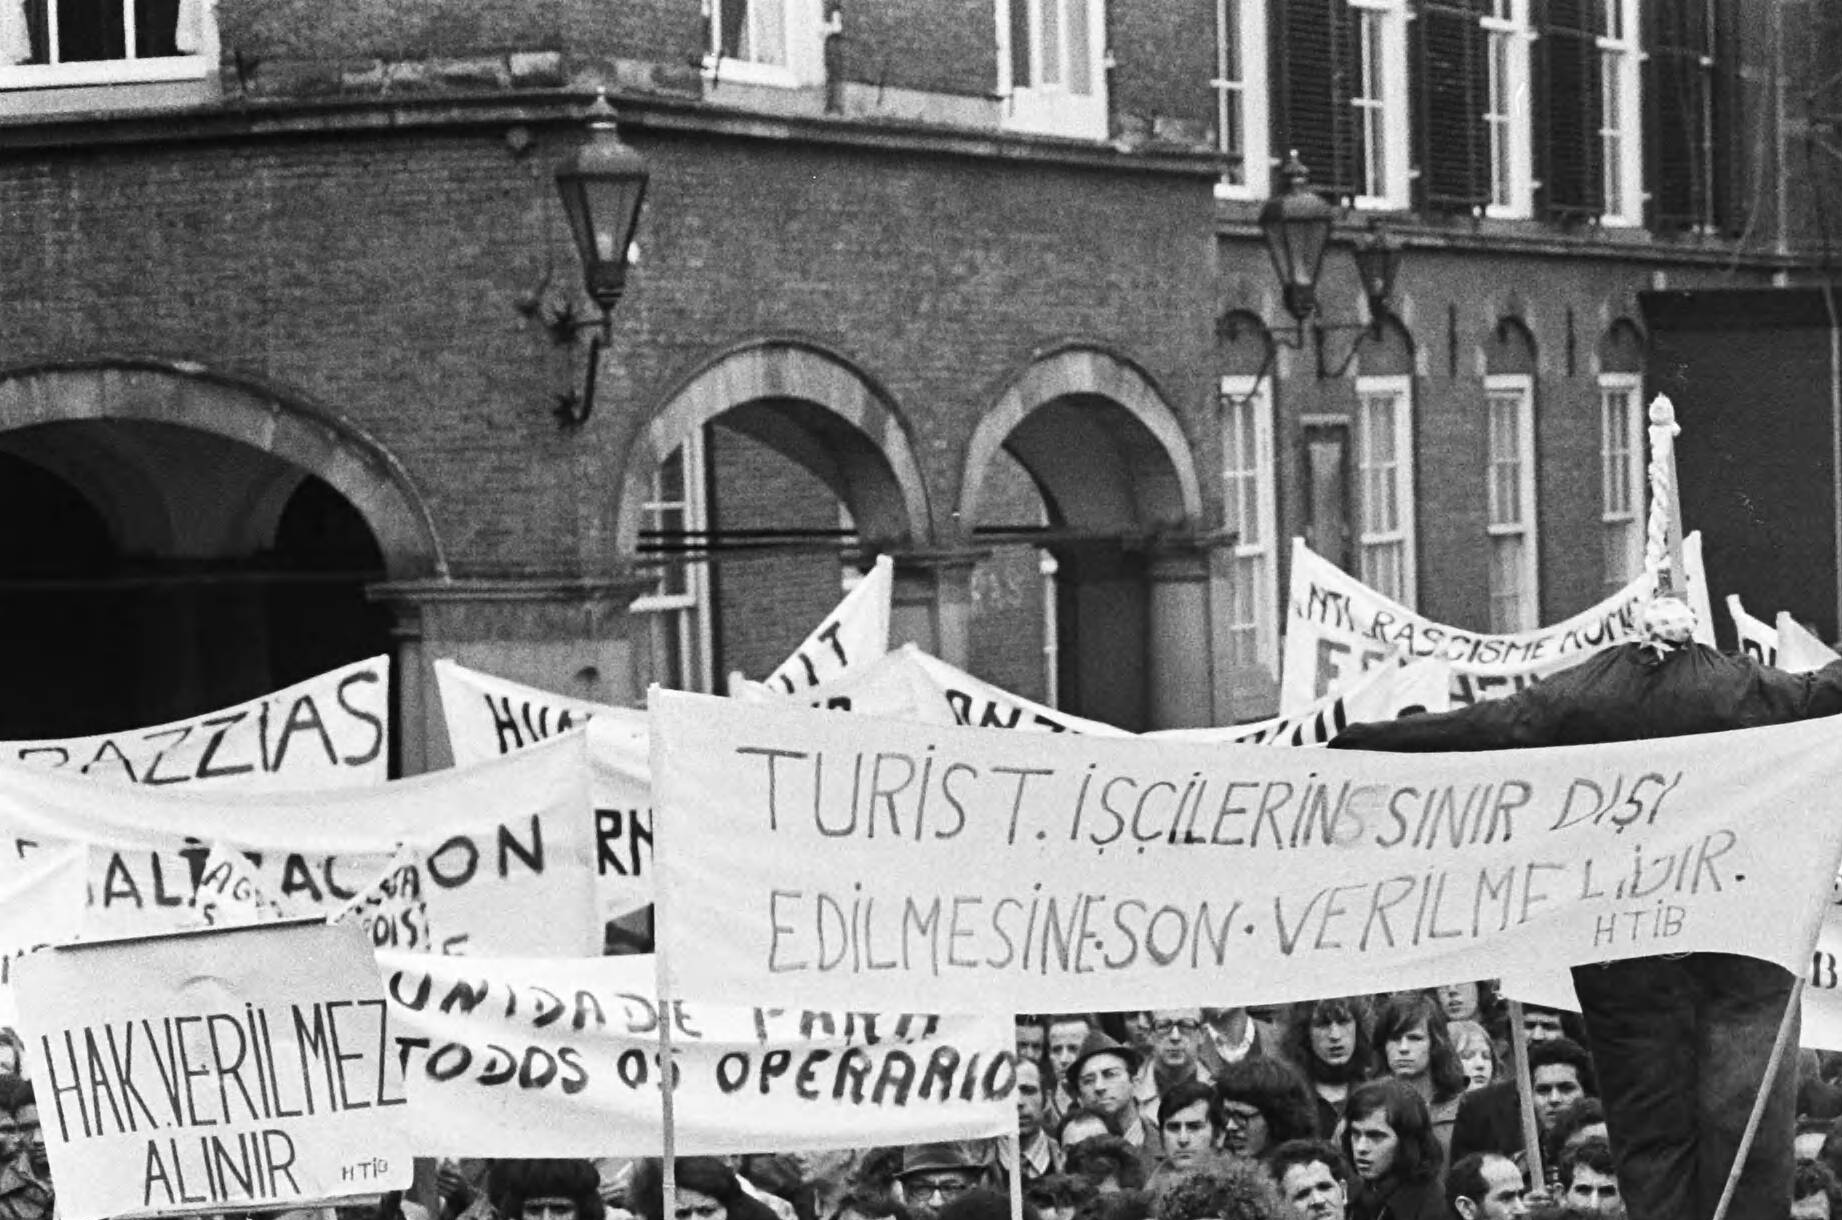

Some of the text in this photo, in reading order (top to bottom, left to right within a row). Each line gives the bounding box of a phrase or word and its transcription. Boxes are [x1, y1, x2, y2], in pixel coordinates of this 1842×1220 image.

[18, 669, 384, 785] AZZIAS
[1375, 777, 1534, 850] SINIR
[1548, 770, 1684, 835] DIŞI
[143, 1129, 301, 1207] ALINIR
